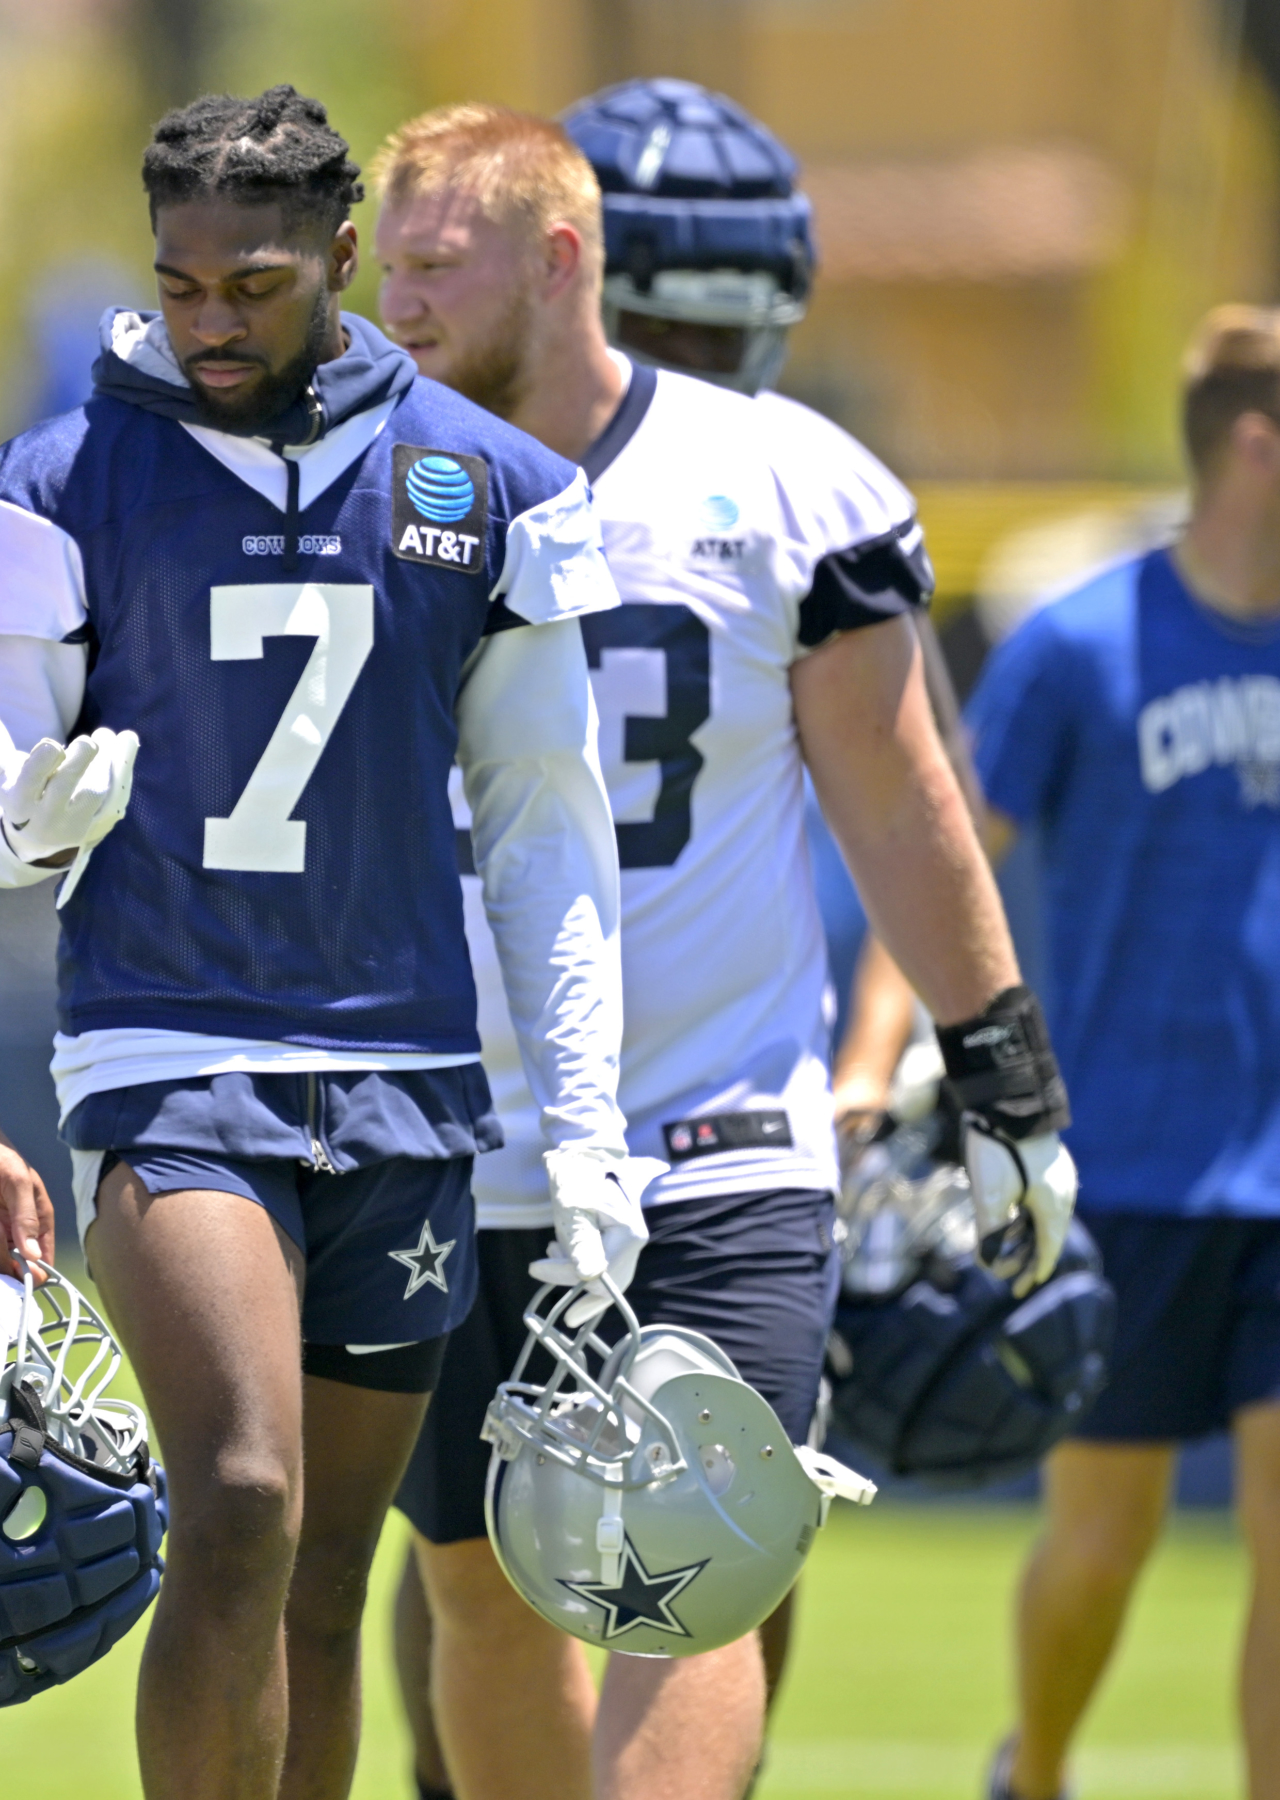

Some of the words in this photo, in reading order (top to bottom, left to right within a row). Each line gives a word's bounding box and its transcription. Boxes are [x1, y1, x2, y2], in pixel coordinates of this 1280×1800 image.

[242, 535, 342, 555] COWOYS
[398, 525, 480, 565] AT&T
[691, 538, 746, 559] AT&T
[203, 583, 374, 873] 7
